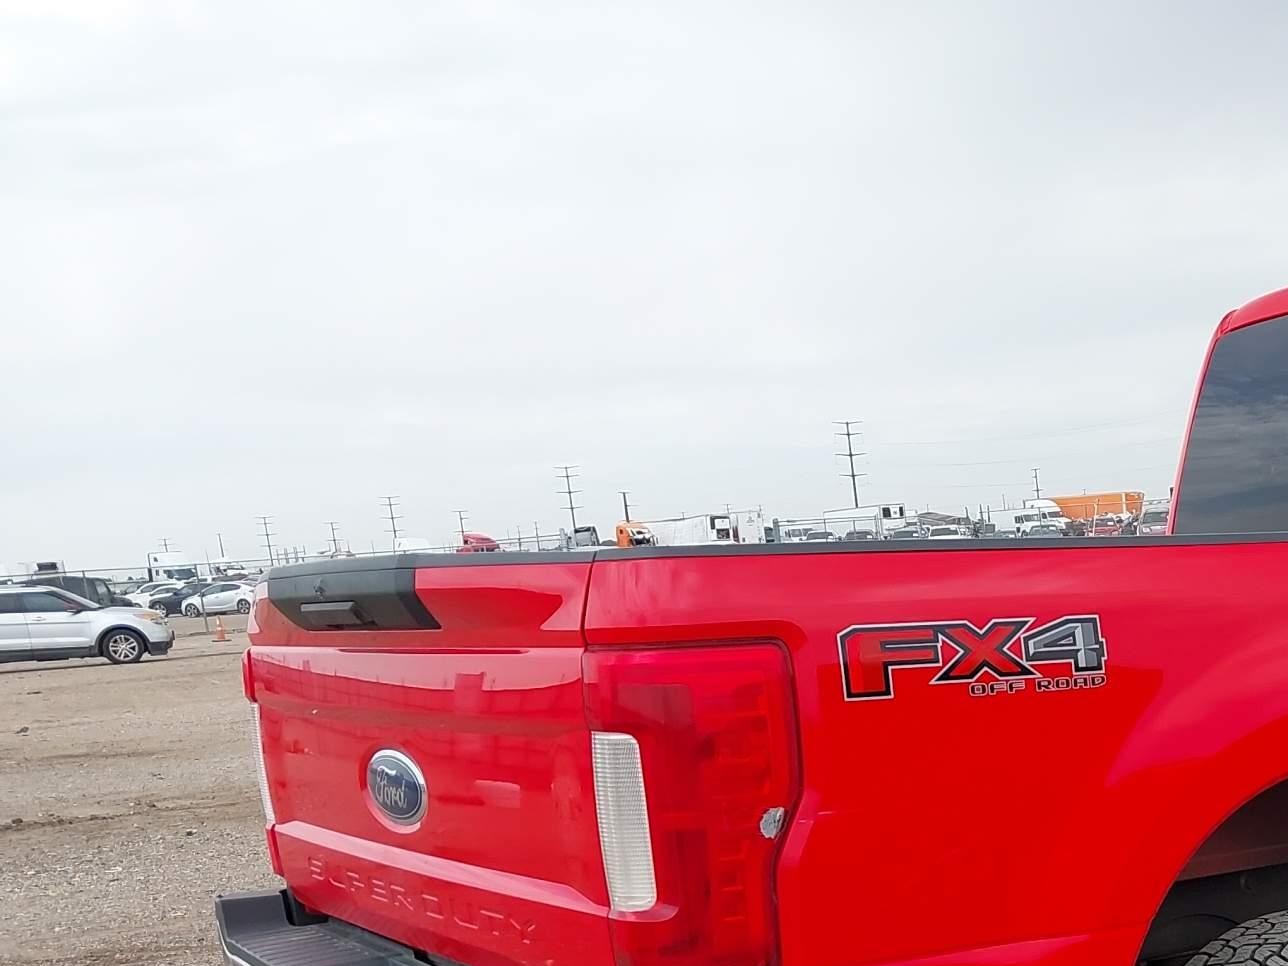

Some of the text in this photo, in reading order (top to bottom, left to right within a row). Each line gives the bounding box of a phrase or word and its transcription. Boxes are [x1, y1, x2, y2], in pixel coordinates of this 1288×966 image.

[837, 614, 1107, 701] FX4
[969, 675, 1107, 697] OFF ROAD
[375, 765, 408, 808] Ford
[308, 855, 537, 944] SUPER DUTY
